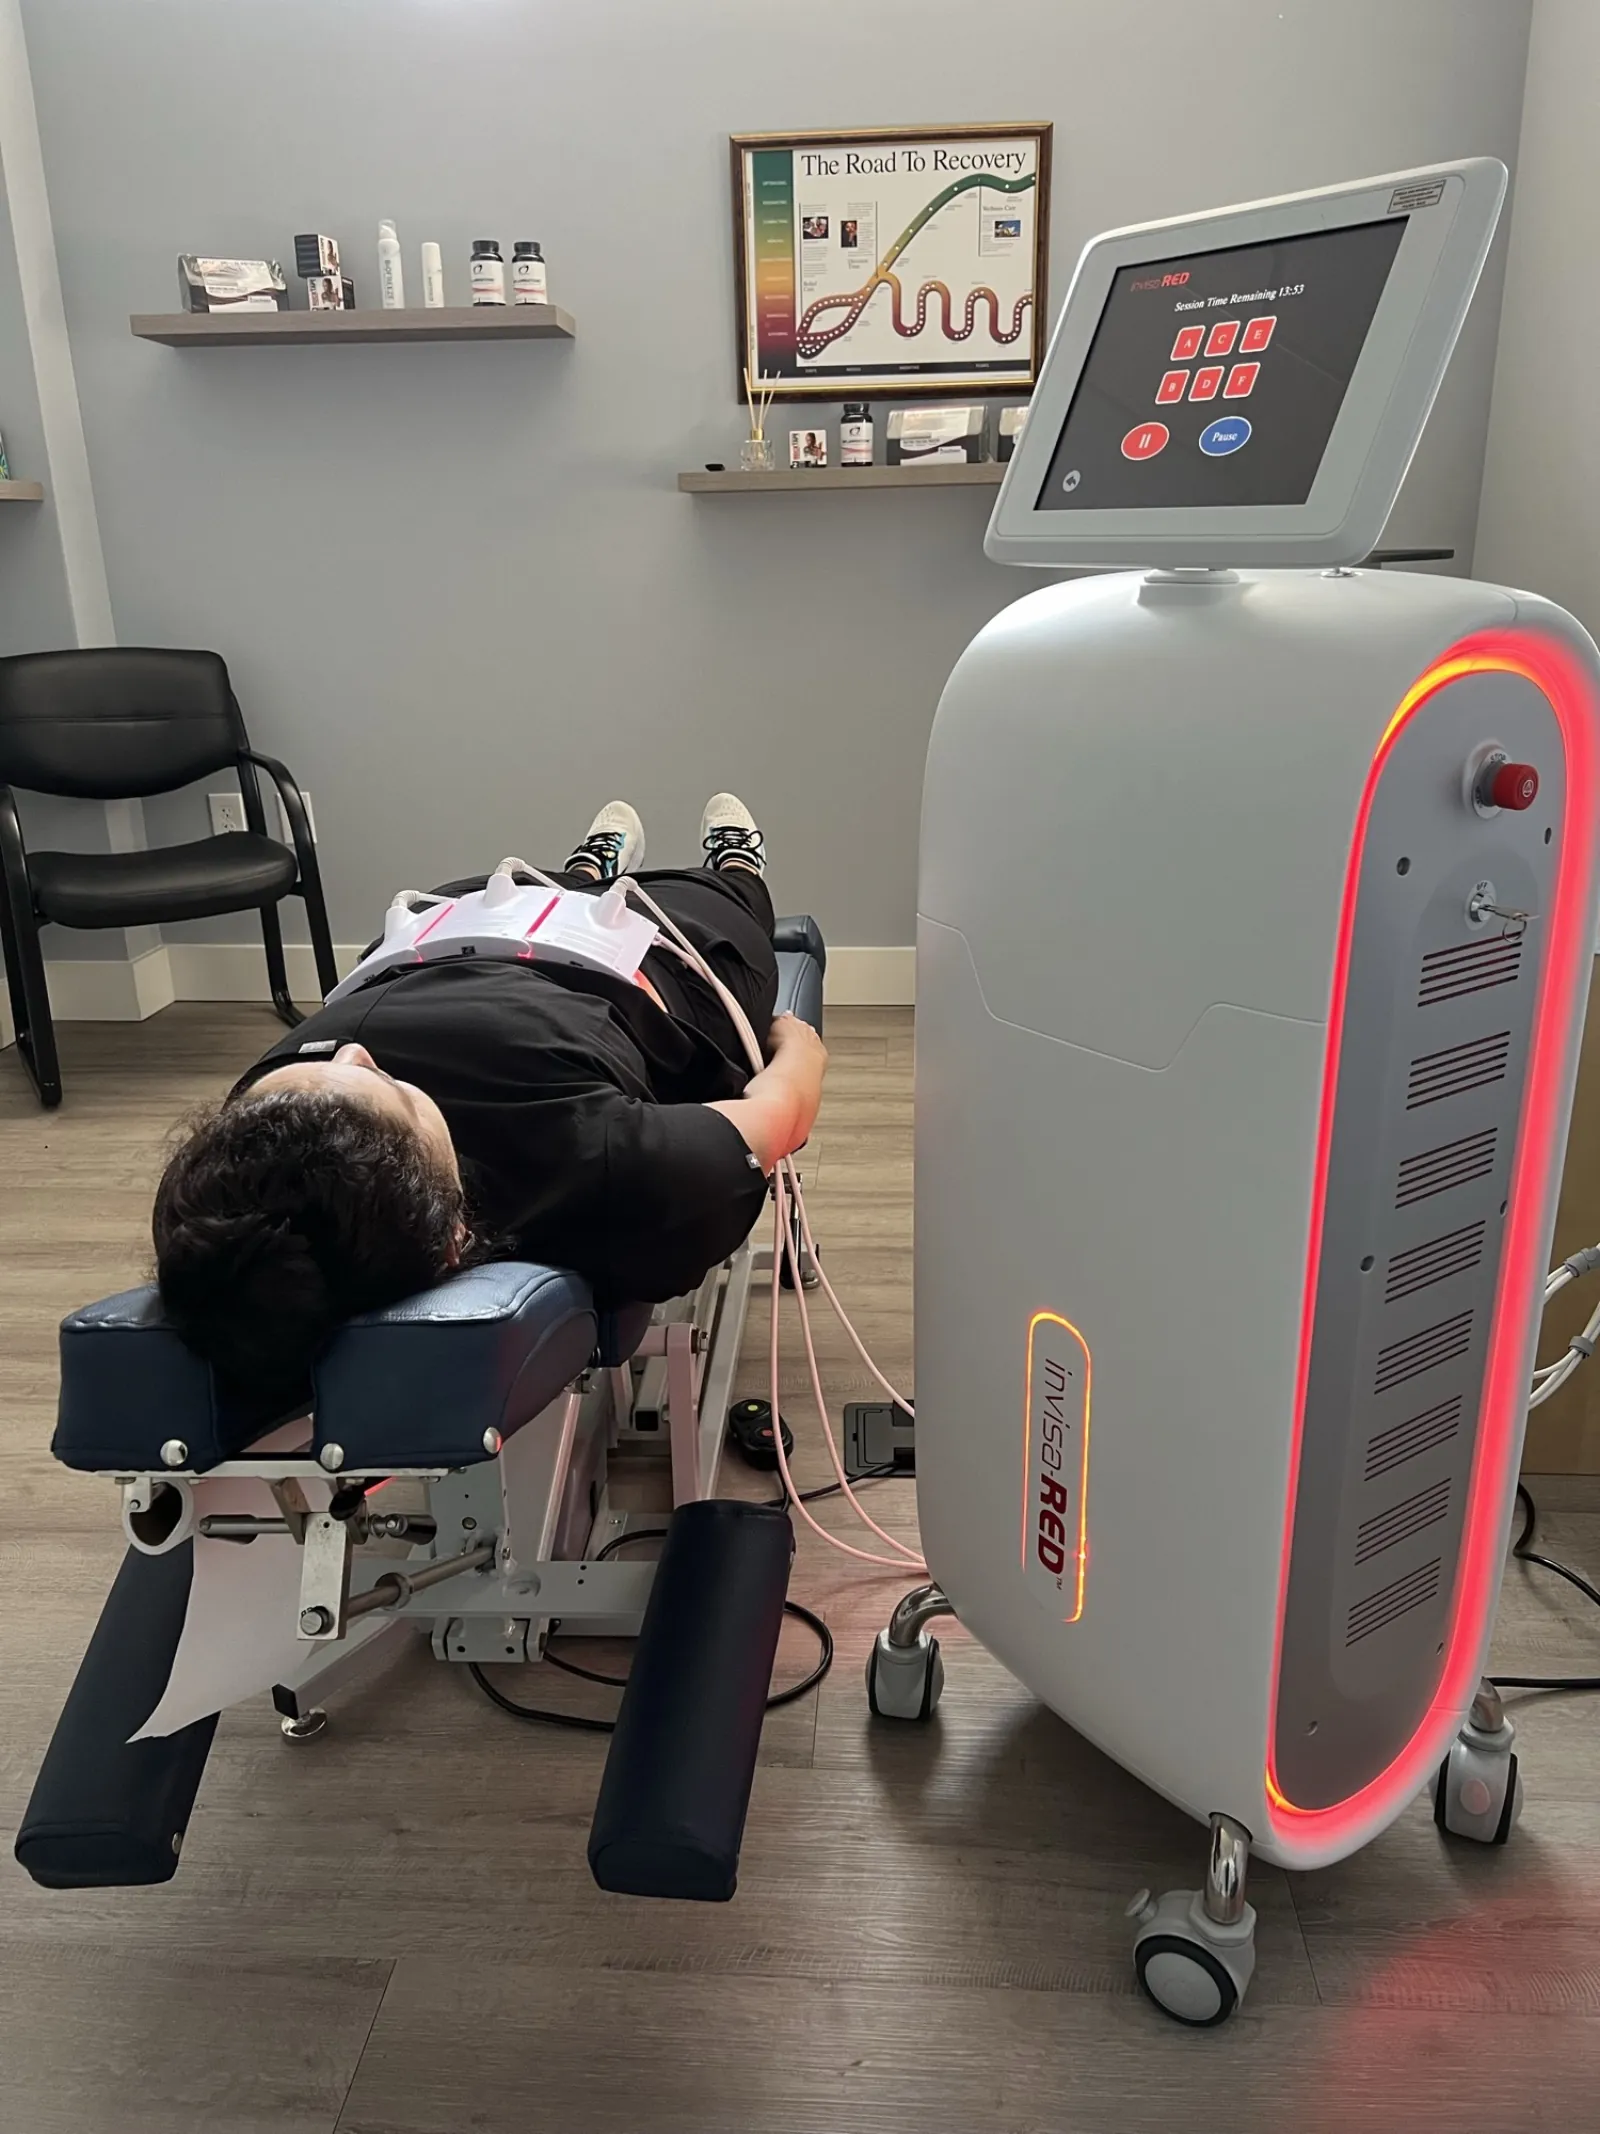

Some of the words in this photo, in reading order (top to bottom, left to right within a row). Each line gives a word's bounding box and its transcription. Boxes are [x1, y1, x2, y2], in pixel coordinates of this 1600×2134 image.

[801, 155, 839, 177] The
[846, 151, 896, 174] Road
[902, 150, 925, 173] To
[934, 150, 1026, 173] Recovery
[1174, 299, 1205, 312] Session
[1207, 297, 1228, 307] Time
[1230, 288, 1277, 303] Remaining
[1279, 284, 1305, 297] 13:53
[1184, 338, 1191, 348] A
[1218, 334, 1227, 344] C
[1253, 329, 1263, 340] E
[1168, 383, 1176, 392] B
[1202, 379, 1211, 389] D
[1237, 375, 1246, 386] F
[1212, 432, 1238, 443] Pause
